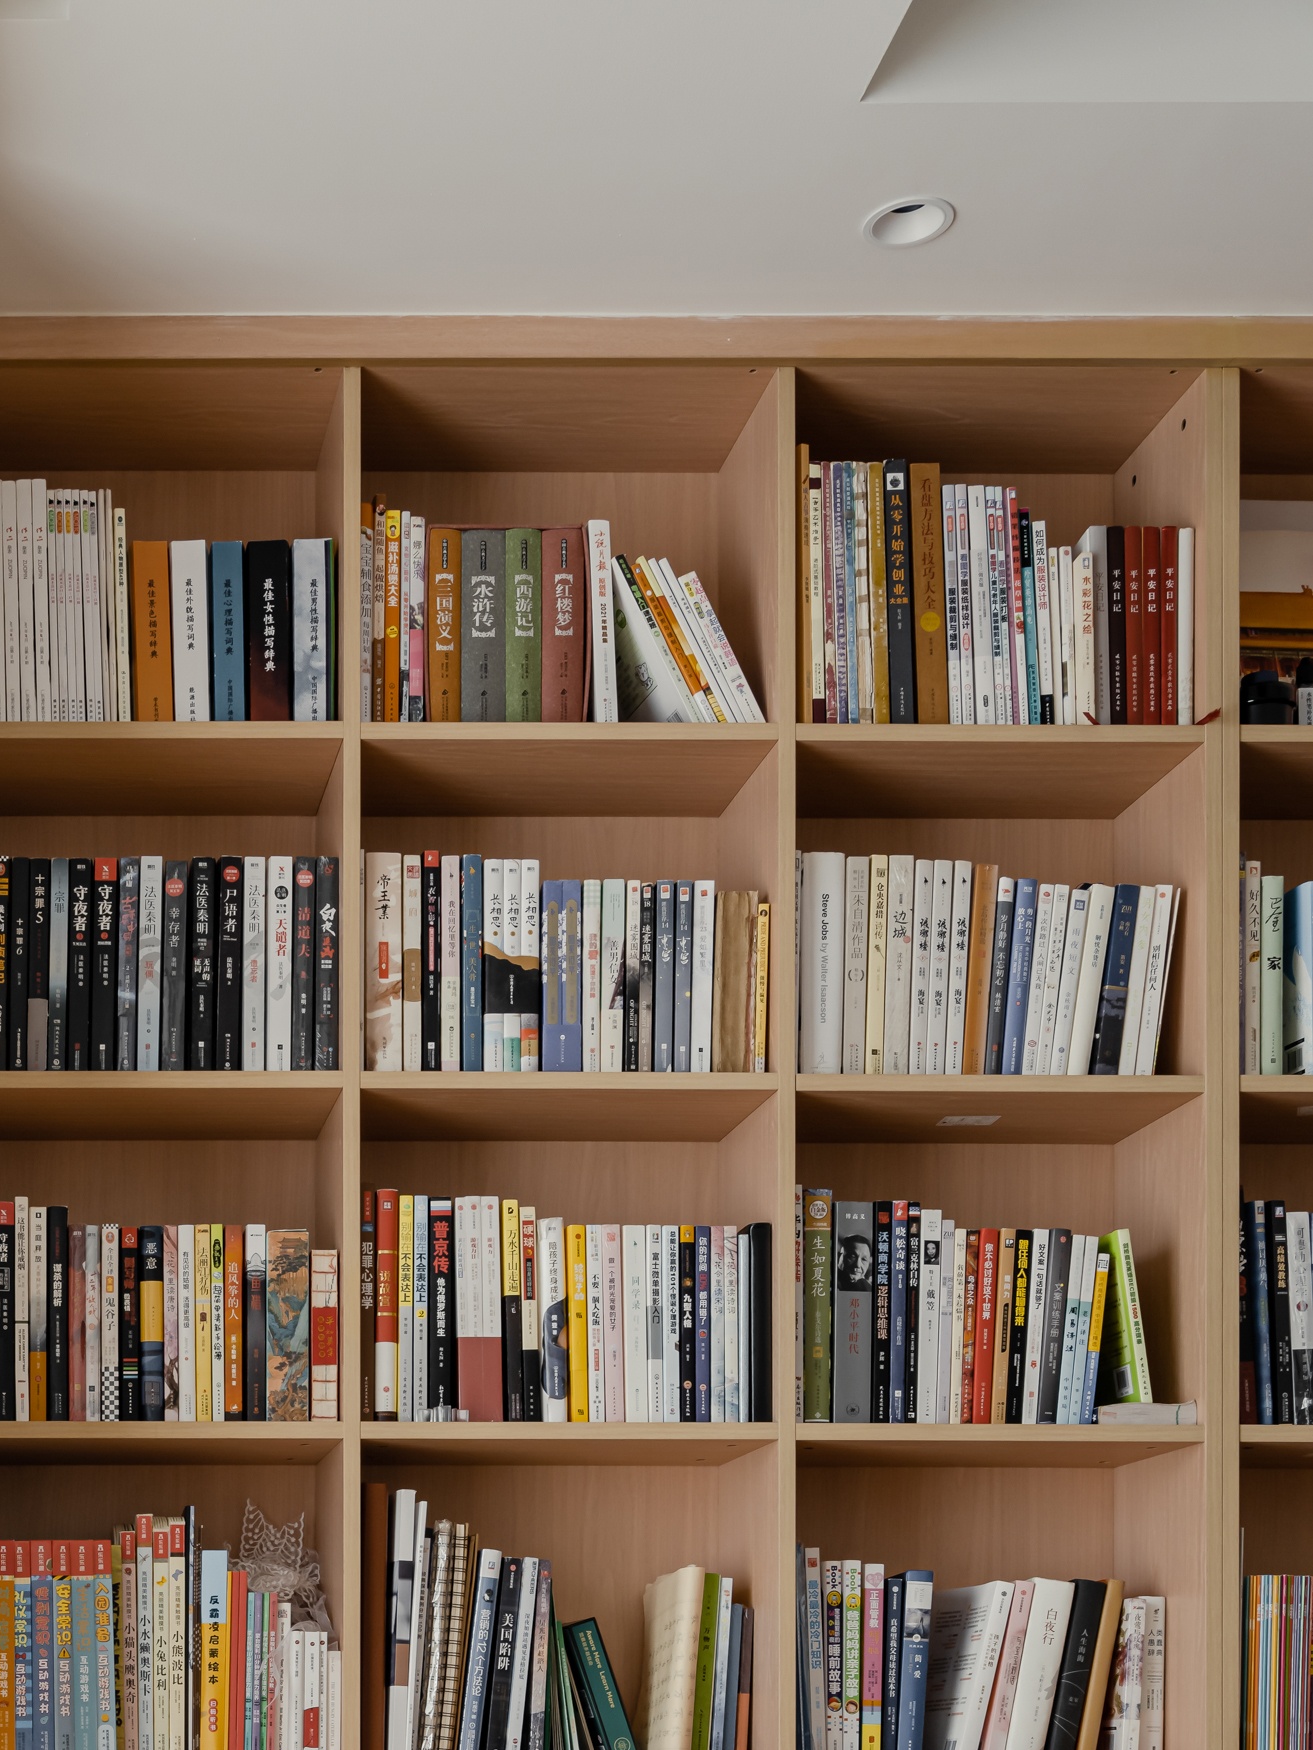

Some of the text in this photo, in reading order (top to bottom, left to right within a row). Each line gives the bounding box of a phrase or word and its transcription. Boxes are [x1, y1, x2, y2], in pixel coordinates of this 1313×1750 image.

[890, 495, 906, 595] 从零开始学创业
[920, 478, 937, 610] 看盘方法与技巧大全
[360, 543, 372, 619] 宝宝辅食添加
[387, 541, 399, 607] 滋补汤煲大全
[1035, 529, 1048, 610] 如何成为服装设计师
[1112, 569, 1122, 612] 平安日记
[1129, 570, 1139, 613] 平安日记
[1147, 568, 1157, 613] 平安日记
[1165, 568, 1175, 612] 平安日记
[147, 579, 159, 659] 最佳景色描写辞典
[185, 578, 195, 651] 最佳外貌描写词典
[223, 578, 234, 656] 最佳心理描写词典
[262, 578, 276, 673] 最佳女性描写辞典
[309, 578, 320, 653] 最佳男性描写辞典
[435, 583, 453, 639] 三国演义
[472, 584, 494, 628] 水浒传
[515, 584, 534, 627] 西游记
[554, 583, 573, 627] 红楼梦
[1081, 576, 1092, 635] 水彩花之绘
[73, 885, 88, 932] 守夜者
[97, 884, 113, 932] 守夜者
[144, 885, 157, 936] 法医秦明
[196, 883, 209, 935] 法医秦明
[223, 889, 238, 933] 尸语者
[248, 884, 261, 934] 法医秦明
[489, 893, 502, 928] 长相思
[507, 893, 520, 928] 长相思
[525, 892, 537, 927] 长相思
[821, 893, 830, 918] Steve
[875, 882, 885, 919] 仓央嘉措
[892, 910, 908, 940] 边城
[1016, 908, 1026, 930] 放心上
[1248, 889, 1260, 943] 好久不见
[169, 907, 181, 948] 幸存者
[275, 918, 288, 957] 天谴者
[297, 907, 310, 957] 清道夫
[447, 900, 456, 959] 我在回忆里等你
[641, 924, 652, 962] 迷雾围城
[821, 919, 830, 941] Jobs
[851, 894, 864, 959] 朱自清作品
[997, 914, 1008, 948] 岁月静好
[608, 940, 619, 986] 善男信女
[820, 951, 829, 978] Walter
[994, 952, 1006, 986] 不忘初心
[1067, 928, 1080, 976] 雨夜短文
[1148, 944, 1161, 992] 别相信任何人
[1267, 956, 1282, 971] 家
[820, 979, 829, 1025] Isaacson
[34, 1223, 43, 1264] 当庭释放
[145, 1242, 158, 1270] 恶意
[433, 1220, 450, 1274] 普京传
[507, 1229, 519, 1293] 万水千山走遍
[523, 1224, 534, 1248] 硬球
[895, 1226, 907, 1271] 晓松奇谈
[53, 1263, 63, 1307] 谋杀的解析
[166, 1251, 176, 1313] 飞花令里读唐诗
[199, 1247, 209, 1296] 去丽江疗伤
[361, 1242, 374, 1310] 犯罪心理学
[401, 1222, 412, 1303] 别输在不会表达上
[416, 1222, 427, 1303] 别输在不会表达上
[548, 1241, 559, 1303] 陪孩子终身成长
[574, 1263, 585, 1301] 给孩子的
[714, 1252, 723, 1315] 飞花令里读宋词
[811, 1235, 826, 1297] 生如夏花
[909, 1237, 919, 1287] 富兰克林自传
[982, 1243, 994, 1321] 你不必讨好这个世界
[1015, 1239, 1029, 1327] 跟任何人都能聊得来
[1035, 1243, 1046, 1310] 好文案一句话就够了
[1276, 1245, 1286, 1290] 高绩效教练
[227, 1262, 239, 1320] 追风筝的人
[378, 1270, 391, 1307] 说故宫
[436, 1277, 446, 1337] 他为俄罗斯而生
[631, 1276, 641, 1310] 同学录
[651, 1252, 661, 1325] 富士微单摄影入门
[683, 1293, 693, 1329] 九型人格
[967, 1275, 975, 1305] 乌合之众
[1050, 1283, 1063, 1339] 文案训练手册
[105, 1297, 116, 1331] 鬼谷子
[848, 1298, 860, 1355] 邓小平时代
[1065, 1306, 1078, 1353] 周易译注
[1078, 1309, 1090, 1346] 老子译注
[830, 1565, 838, 1590] Book
[850, 1568, 858, 1591] Book
[14, 1590, 28, 1648] 礼仪常识
[55, 1583, 72, 1647] 安全常识
[95, 1582, 111, 1643] 入园准备
[869, 1590, 880, 1629] 正面管教
[1043, 1608, 1058, 1646] 白夜行
[123, 1623, 137, 1704] 小猫头鹰奥奇
[156, 1635, 168, 1692] 小兔比利
[171, 1631, 184, 1686] 小熊波比
[208, 1595, 220, 1685] 反霸凌启蒙绘本
[497, 1613, 513, 1671] 美国陷阱
[845, 1611, 859, 1698] 爸爸妈妈讲亲子故事
[888, 1618, 898, 1698] 真希望我父母读过这本书
[987, 1633, 998, 1668] 孩子的品格
[1076, 1628, 1090, 1663] 人生海海
[0, 1653, 9, 1698] 互动游戏书
[15, 1663, 27, 1717] 互动游戏书
[38, 1659, 49, 1714] 互动游戏书
[58, 1660, 71, 1717] 互动游戏书
[79, 1655, 90, 1703] 互动游戏书
[98, 1654, 111, 1711] 互动游戏书
[585, 1630, 616, 1710] Aware More Learn More
[828, 1644, 841, 1695] 睡前故事
